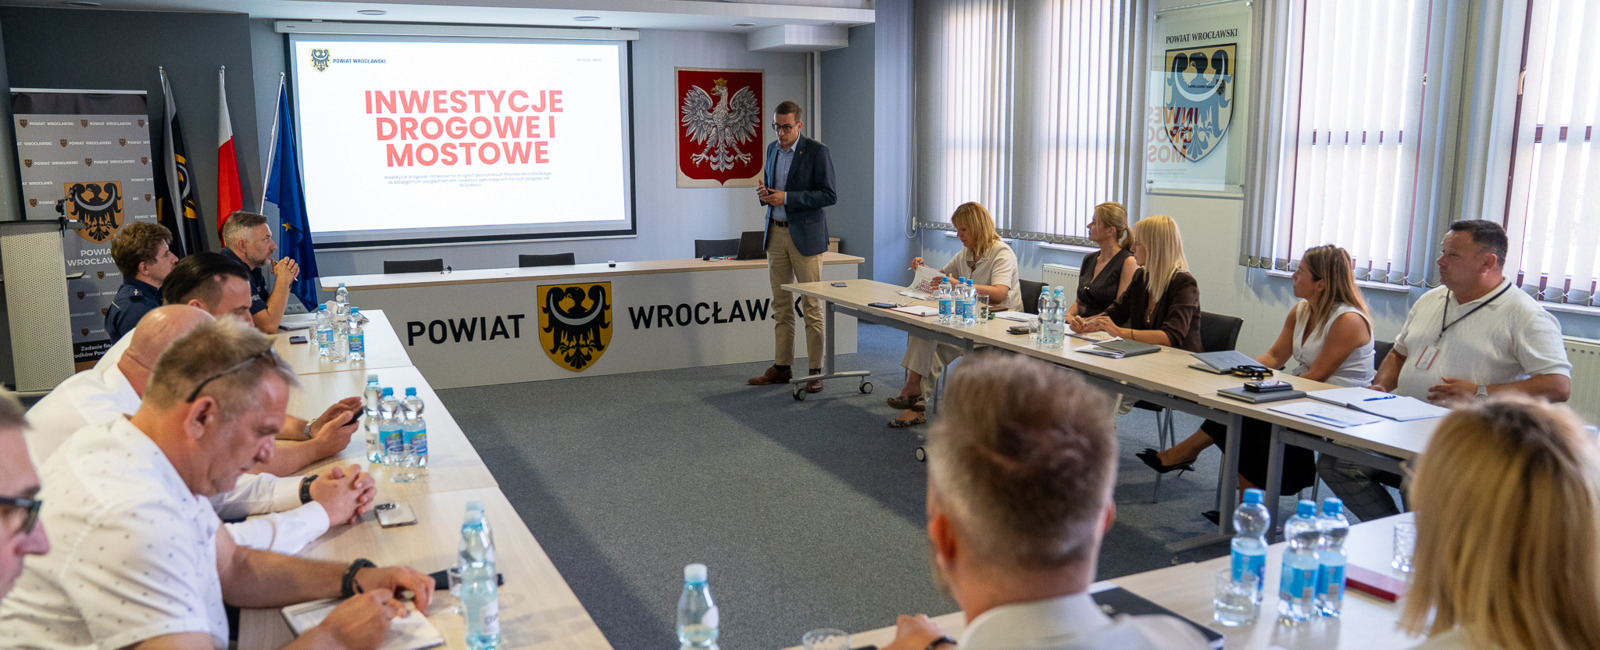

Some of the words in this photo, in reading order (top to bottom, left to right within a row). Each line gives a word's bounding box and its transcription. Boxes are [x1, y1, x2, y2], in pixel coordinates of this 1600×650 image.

[1165, 33, 1190, 44] POWIAT
[1192, 28, 1239, 41] WROCŁAWSKI
[365, 90, 564, 114] INWESTYCJE
[376, 115, 541, 141] DROGOWE
[548, 115, 556, 138] I
[386, 141, 549, 168] MOSTOWE
[67, 256, 115, 266] WROCŁAW
[80, 248, 111, 256] POWIA
[406, 313, 525, 346] POWIAT
